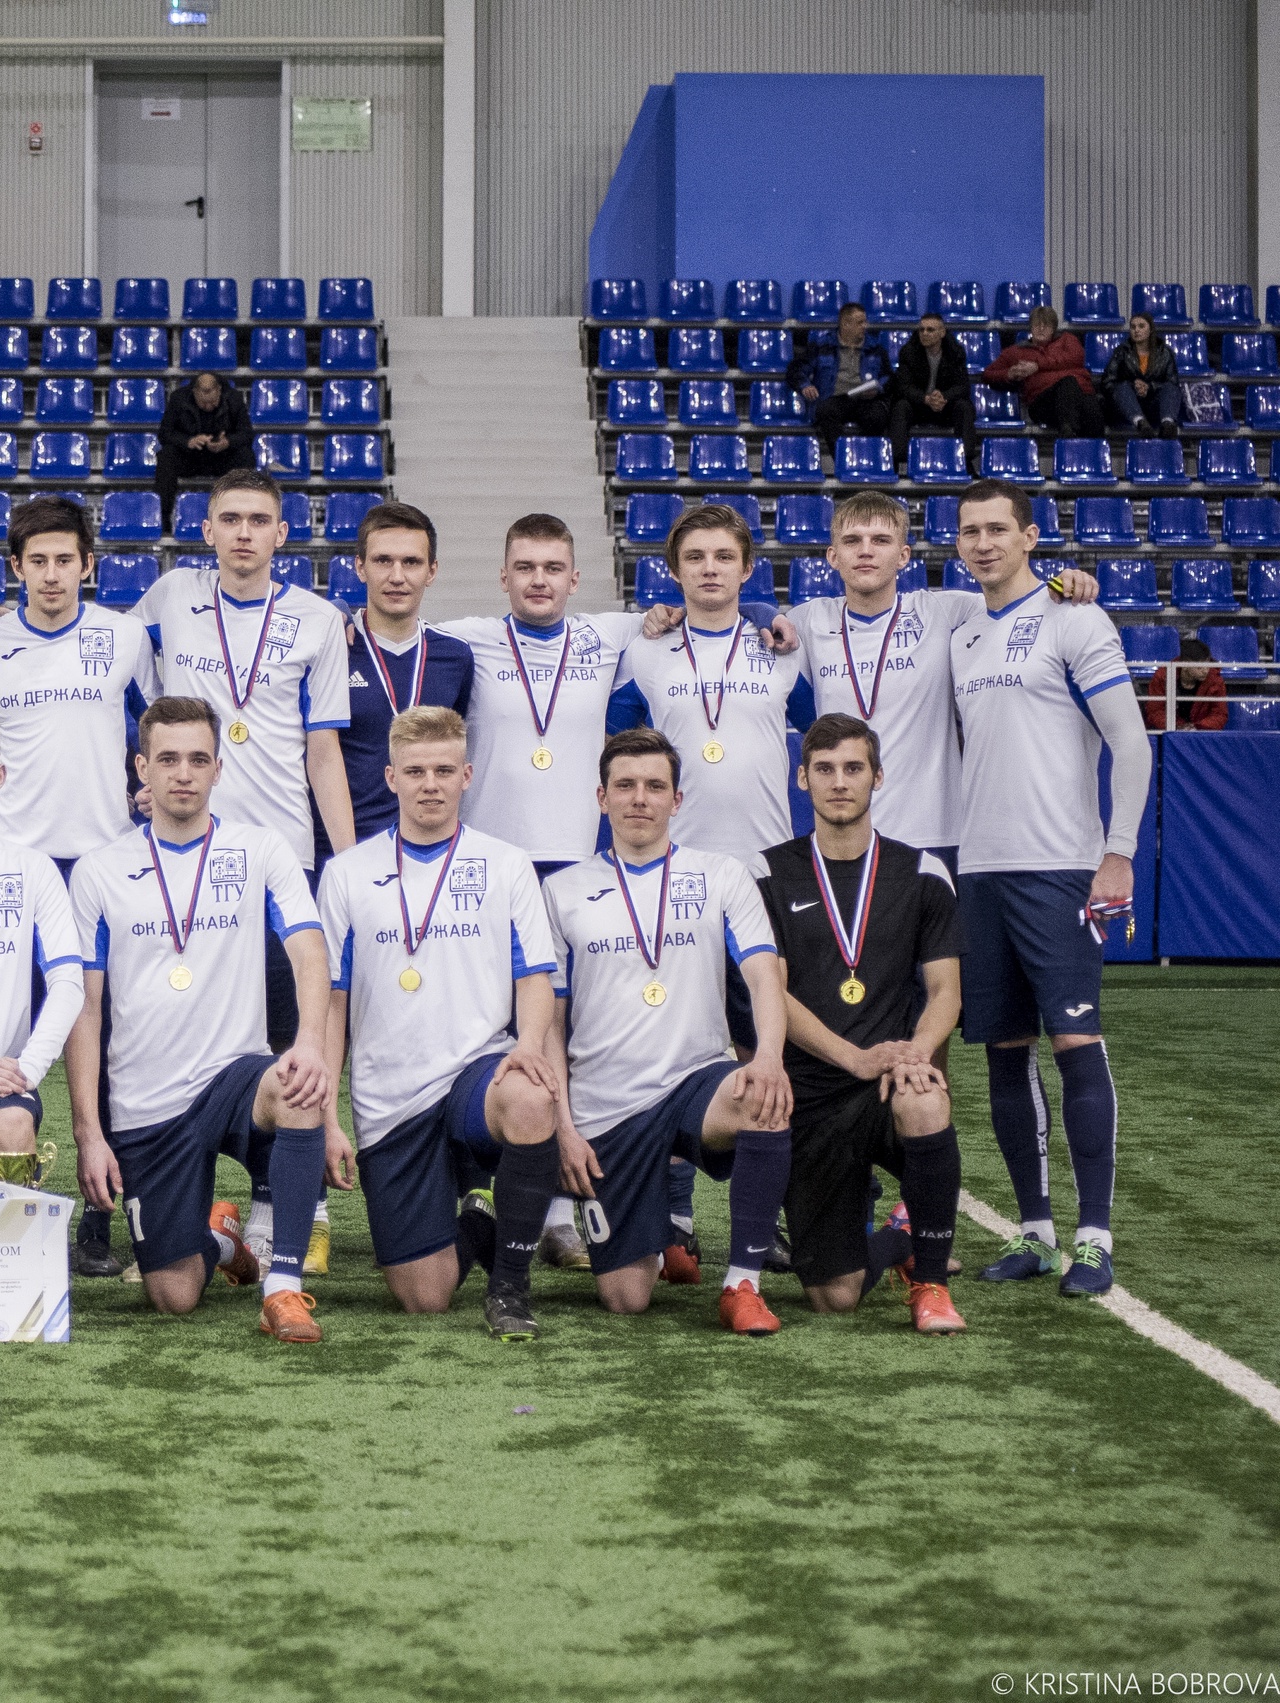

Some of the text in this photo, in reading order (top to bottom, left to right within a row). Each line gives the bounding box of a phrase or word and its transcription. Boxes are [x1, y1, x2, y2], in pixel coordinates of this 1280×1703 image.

[892, 630, 923, 648] ТГУ
[176, 654, 194, 667] ФК
[1005, 646, 1033, 662] ТГУ
[81, 660, 113, 677] ТГУ
[747, 658, 775, 674] ТГУ
[819, 665, 838, 678] ФК
[497, 670, 520, 681] ФК
[667, 683, 688, 697] ФК
[966, 673, 1023, 696] ДЕРЖАВА
[0, 687, 103, 709] ФК ДЕРЖАВА
[211, 883, 246, 903] ТГУ
[451, 892, 486, 911] ТГУ
[671, 901, 706, 920] ТГУ
[131, 922, 155, 937] ФК
[375, 930, 399, 944] ФК
[587, 938, 609, 954] ФК
[919, 1230, 953, 1239] JAKO
[506, 1241, 539, 1251] JAKO
